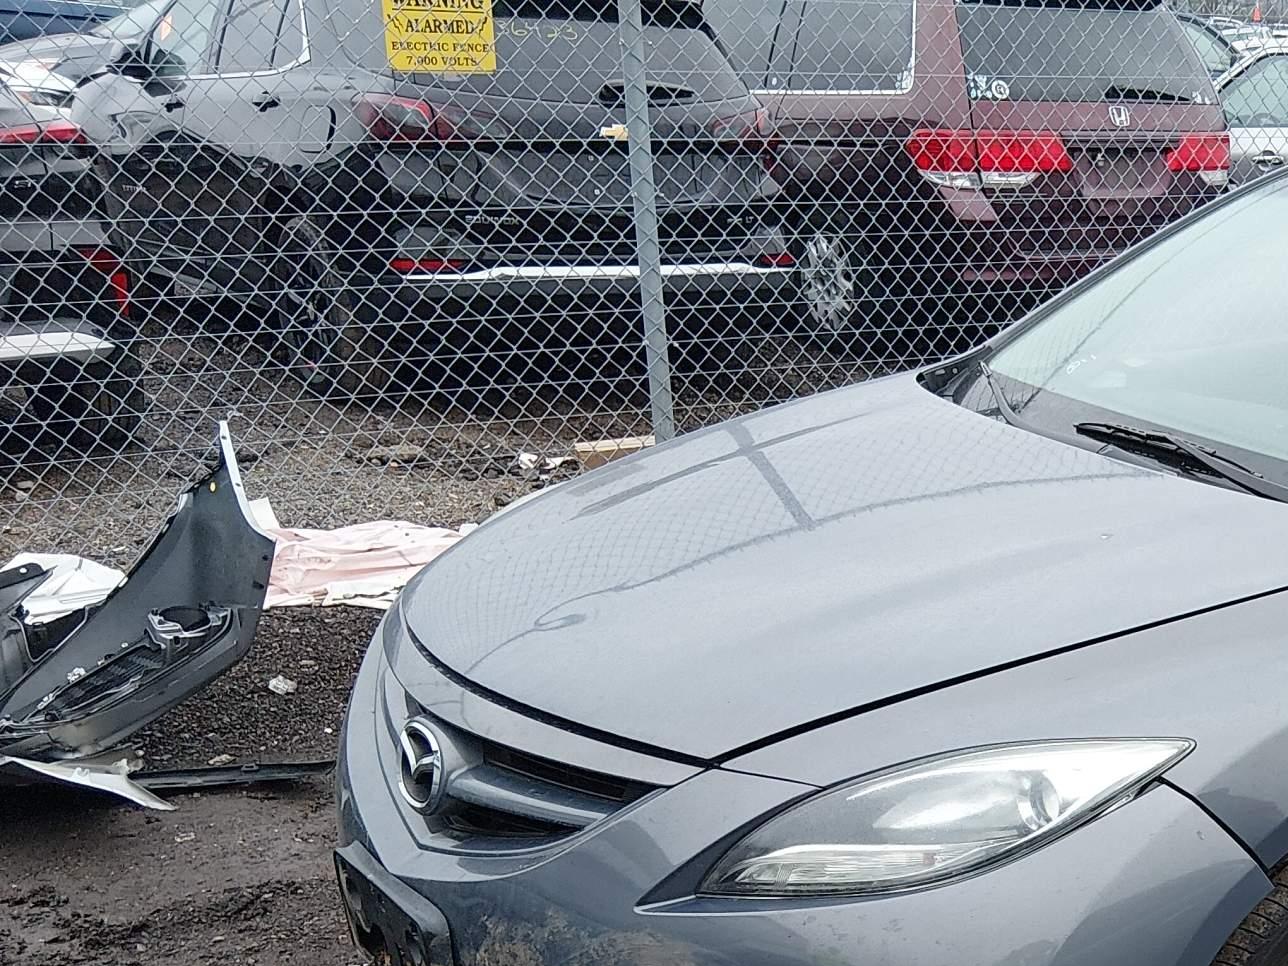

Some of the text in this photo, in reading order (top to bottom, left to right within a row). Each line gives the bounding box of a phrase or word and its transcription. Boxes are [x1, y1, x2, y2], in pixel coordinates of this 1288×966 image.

[405, 19, 475, 34] ALARMED
[391, 41, 489, 53] ELECTRIC FENCE
[406, 56, 477, 66] 7,000 VOLTS
